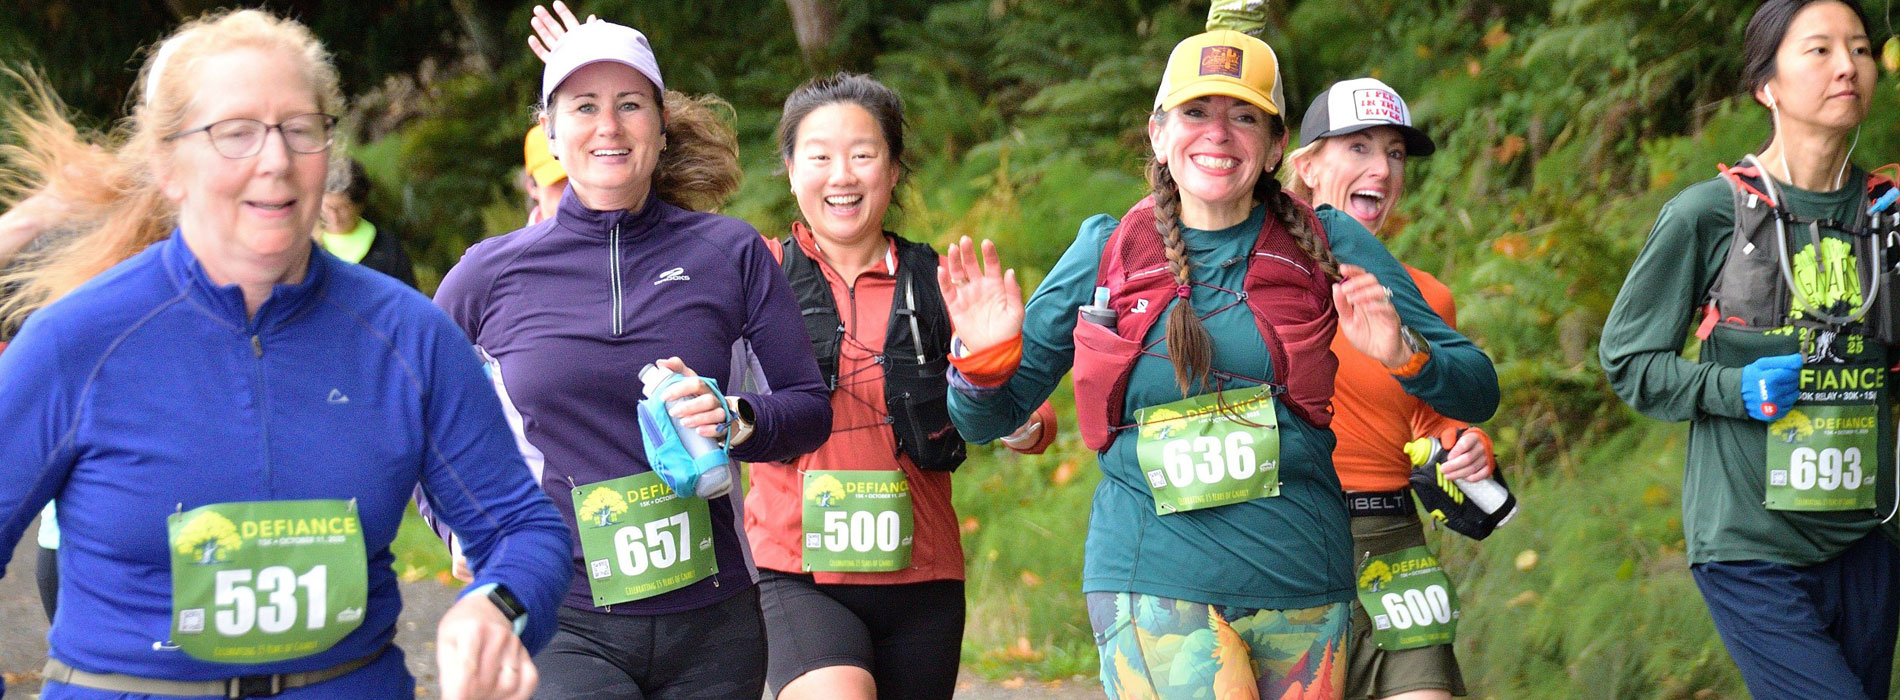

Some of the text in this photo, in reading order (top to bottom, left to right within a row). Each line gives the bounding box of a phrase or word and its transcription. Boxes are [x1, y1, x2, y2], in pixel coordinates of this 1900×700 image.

[1365, 108, 1402, 123] RIVER
[1381, 100, 1401, 114] THE
[1847, 341, 1864, 354] 25
[1187, 396, 1269, 421] DEFIANCE
[1815, 391, 1838, 401] RELAY
[1843, 391, 1859, 400] 30K
[1815, 416, 1875, 429] DEFIANCE
[1163, 431, 1256, 488] 636
[1790, 447, 1862, 491] 693
[242, 517, 357, 539] DEFIANCE
[824, 510, 900, 553] 500
[613, 511, 691, 577] 657
[215, 564, 327, 637] 531
[1381, 584, 1451, 630] 600
